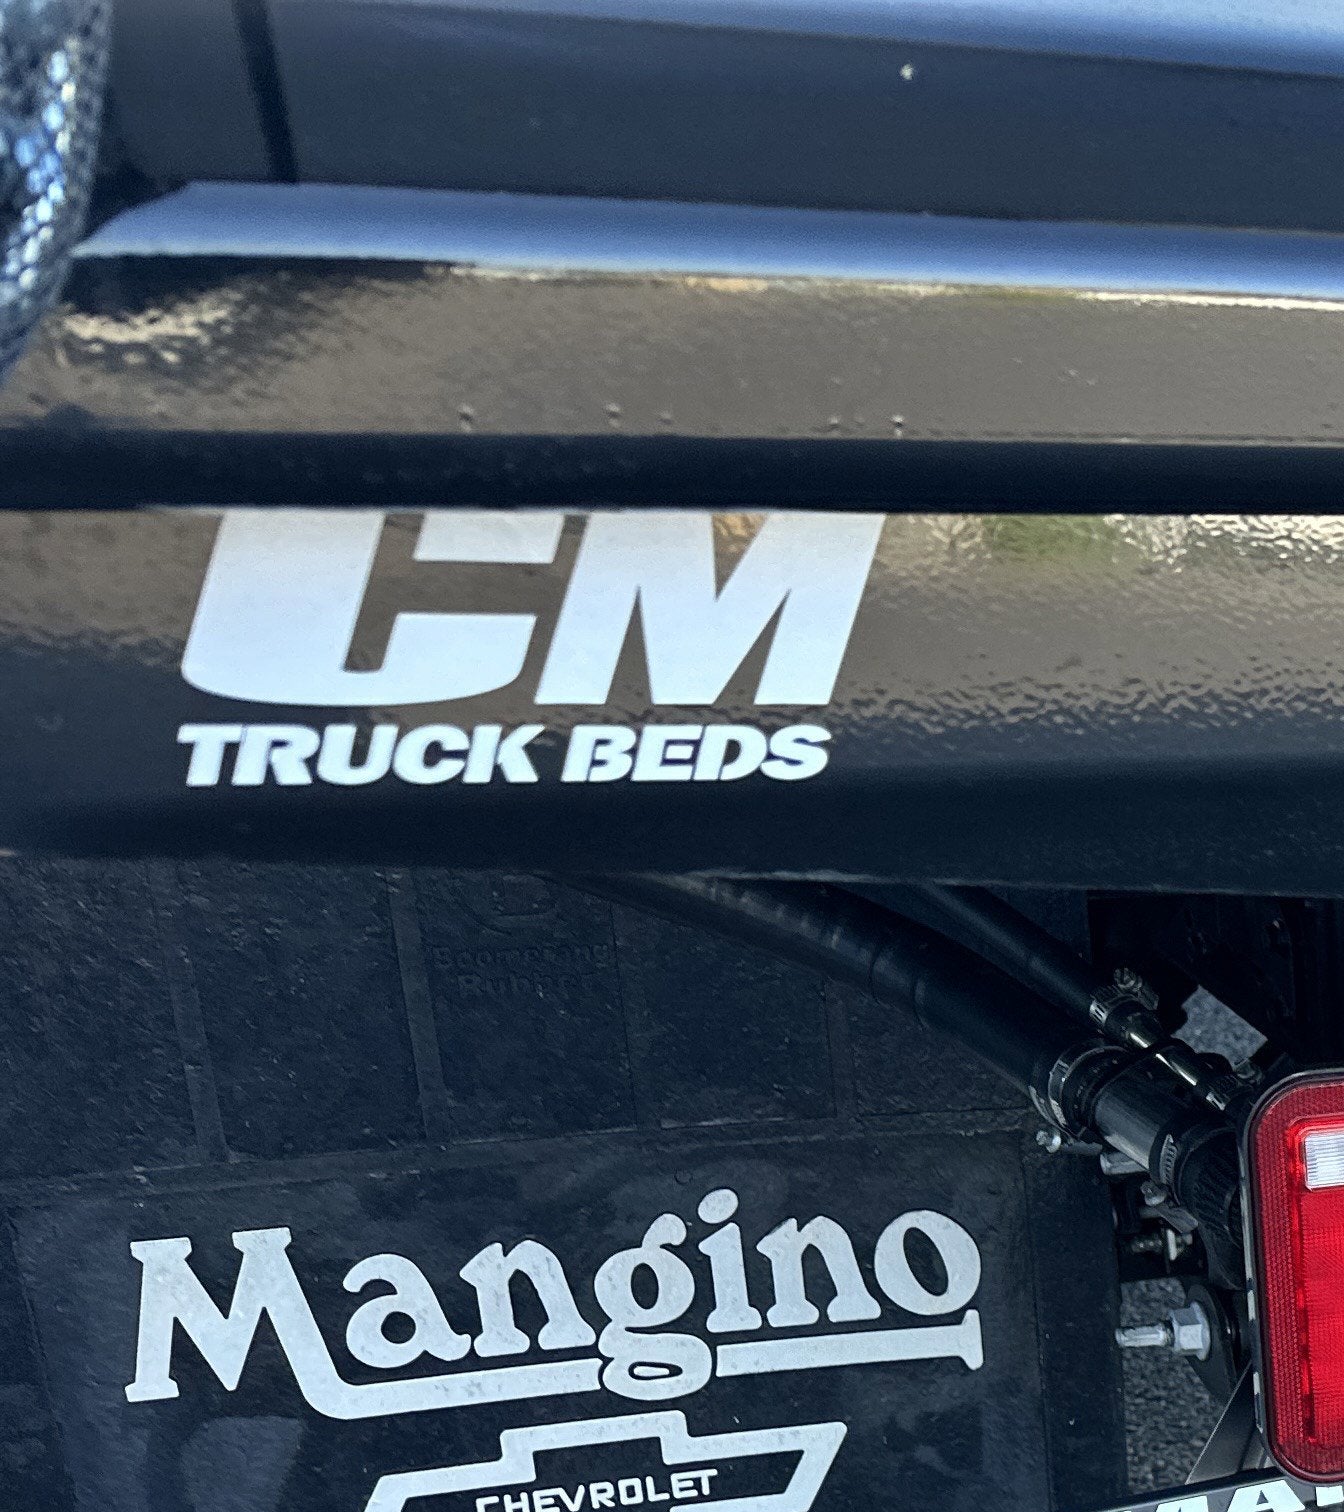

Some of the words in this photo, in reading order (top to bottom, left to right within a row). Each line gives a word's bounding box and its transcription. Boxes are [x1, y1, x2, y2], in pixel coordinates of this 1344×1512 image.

[181, 508, 888, 706] CM
[177, 723, 545, 787] TRUCK
[561, 723, 832, 783] BEDS
[125, 1187, 984, 1421] Mangino
